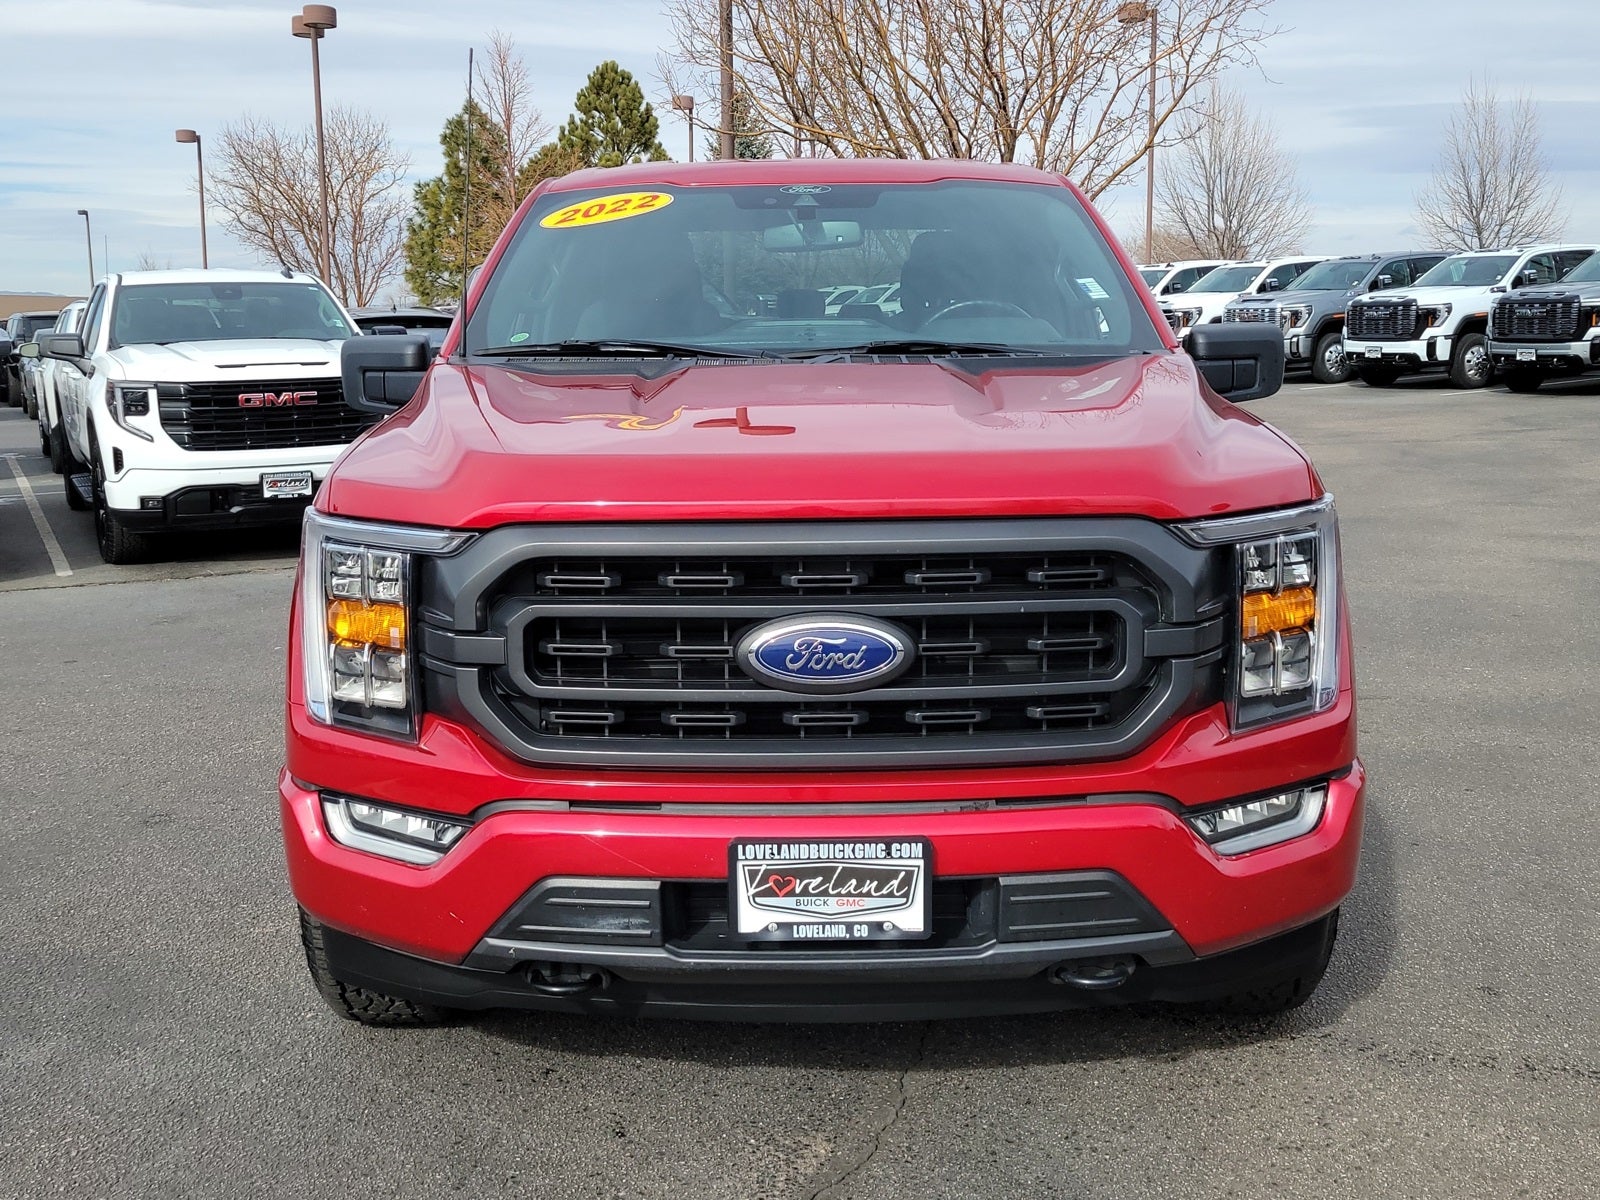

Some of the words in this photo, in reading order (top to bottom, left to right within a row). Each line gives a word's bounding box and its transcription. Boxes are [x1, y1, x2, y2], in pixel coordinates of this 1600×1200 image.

[553, 194, 661, 225] 2022
[238, 391, 318, 408] GMC
[785, 636, 867, 671] Ford
[737, 842, 923, 860] LOVELANDBUICKGMC.COM
[795, 898, 830, 907] BUICK
[835, 898, 866, 907] GMC
[793, 924, 850, 938] LOVELAND,
[853, 924, 869, 937] CO
